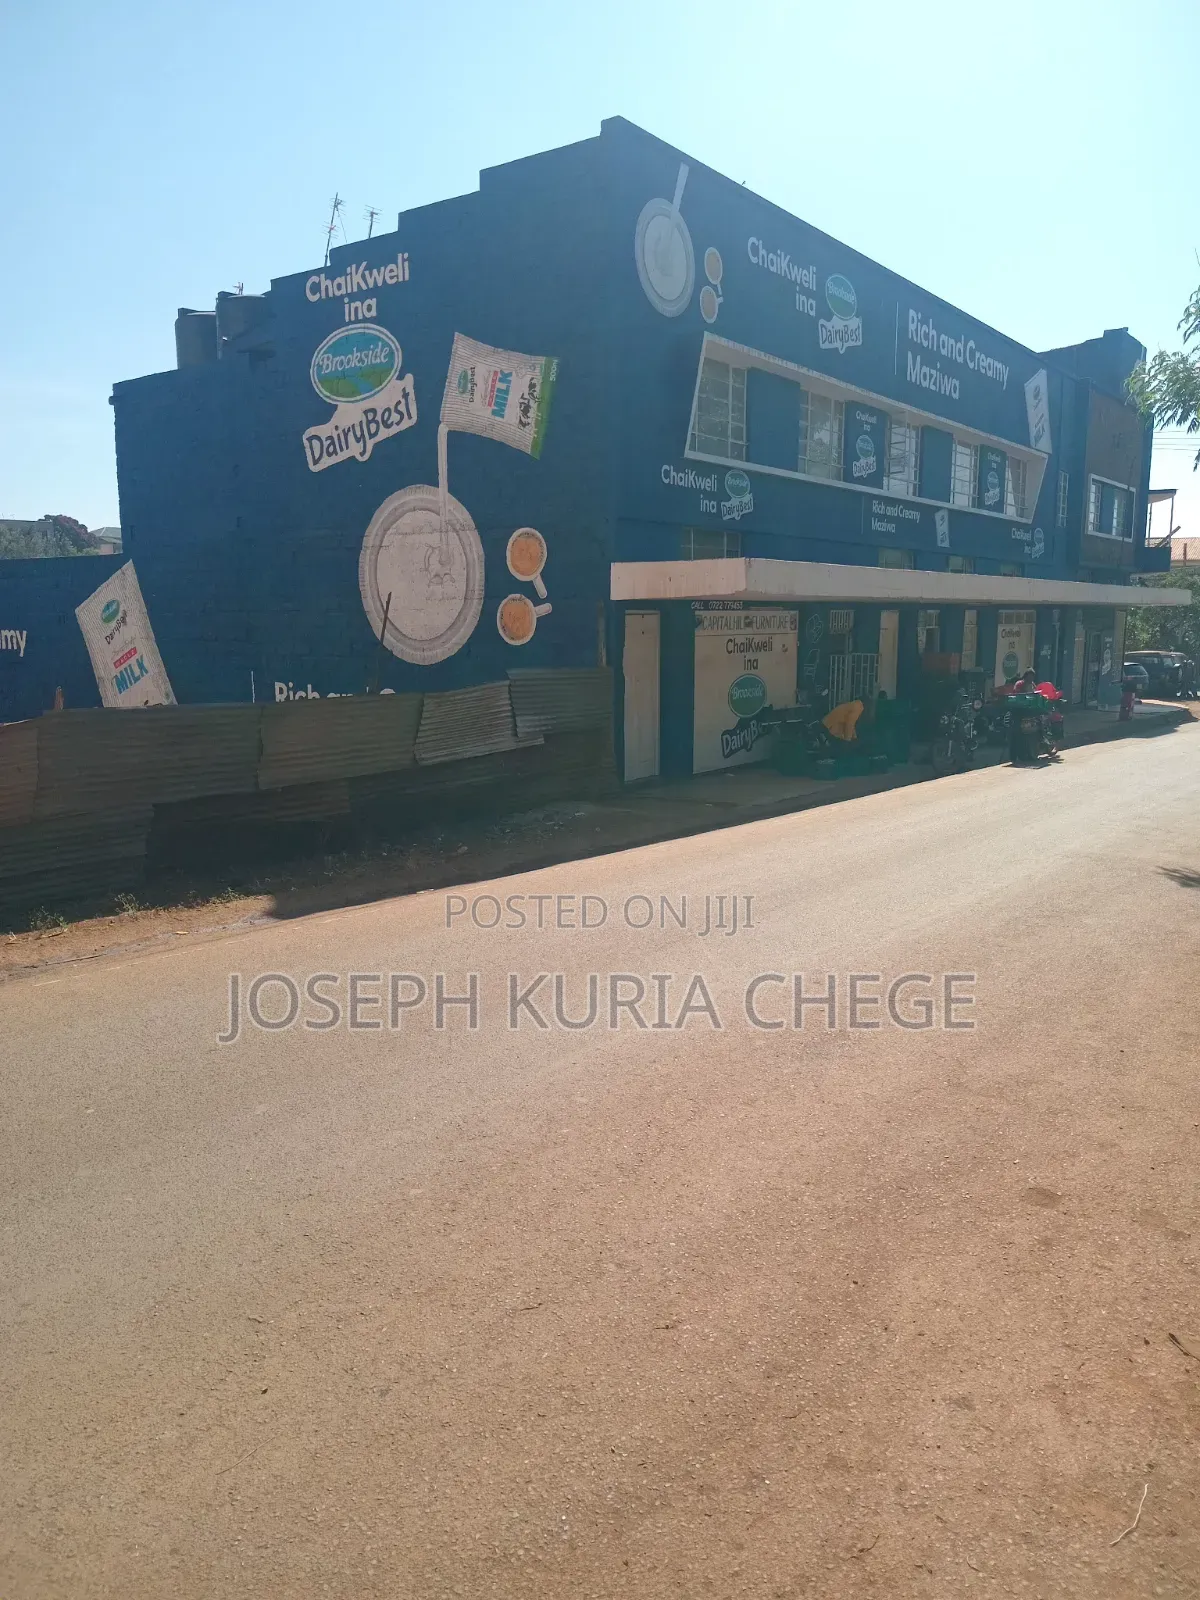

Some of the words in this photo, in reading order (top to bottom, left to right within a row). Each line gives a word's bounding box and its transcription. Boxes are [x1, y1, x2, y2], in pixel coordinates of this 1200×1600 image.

[305, 253, 409, 302] ChaiKweli
[748, 237, 817, 292] ChaiKweli
[344, 297, 377, 322] ina
[795, 285, 816, 318] ina
[317, 342, 390, 375] Brookside
[908, 308, 937, 352] Rich
[939, 325, 964, 364] and
[965, 339, 1010, 391] Creamy
[907, 351, 960, 400] Maziwa
[491, 369, 513, 419] MILK
[305, 387, 414, 466] DairyBest
[661, 464, 717, 492] ChaiKweli
[700, 494, 717, 514] ina
[872, 500, 886, 515] Rich
[886, 503, 898, 518] and
[898, 505, 921, 523] Creamy
[871, 518, 896, 533] Maziwa
[0, 629, 27, 657] my
[726, 636, 773, 654] ChaiKweli
[113, 656, 149, 695] MILK
[743, 656, 759, 671] ina
